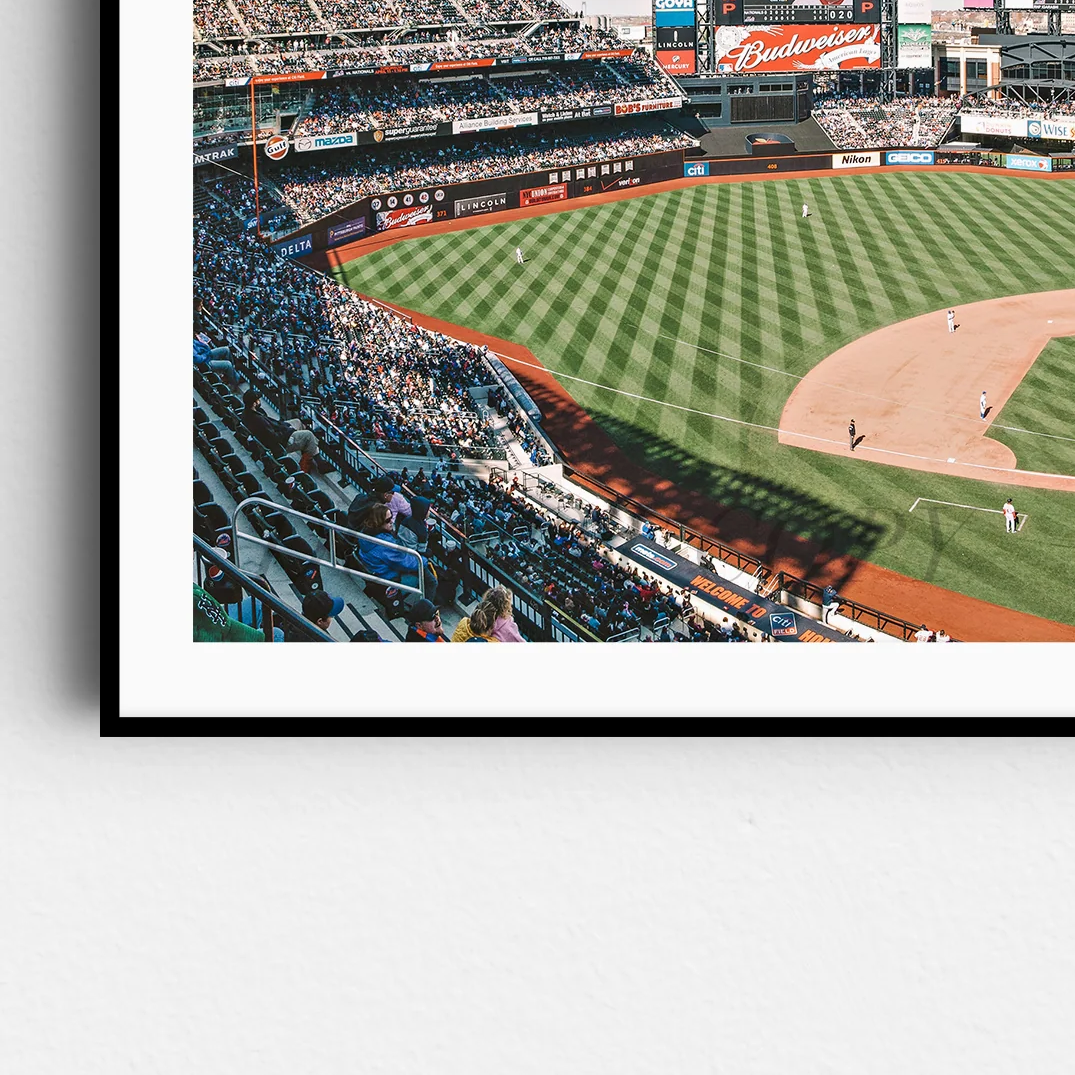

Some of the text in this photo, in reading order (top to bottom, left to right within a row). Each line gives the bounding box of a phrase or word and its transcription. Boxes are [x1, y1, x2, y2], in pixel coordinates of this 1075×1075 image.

[830, 10, 853, 19] 0 2 0
[726, 25, 871, 71] Budweiser
[615, 103, 641, 115] BOB'S
[641, 101, 673, 112] FURNITURE
[458, 115, 532, 129] Alliance Building Services
[1043, 120, 1068, 134] WISE
[267, 141, 287, 154] Gulf
[314, 135, 353, 147] mazda
[193, 147, 235, 164] MTRAK
[841, 155, 872, 165] Nikon
[887, 153, 933, 163] GEICO
[1011, 157, 1037, 168] xerox
[687, 165, 704, 176] citi
[619, 176, 640, 186] verizon
[461, 197, 506, 211] LINCOLN
[384, 205, 430, 229] Budweiser
[281, 239, 312, 257] DELTA
[690, 575, 767, 619] WELCOME TO
[772, 615, 793, 627] citi
